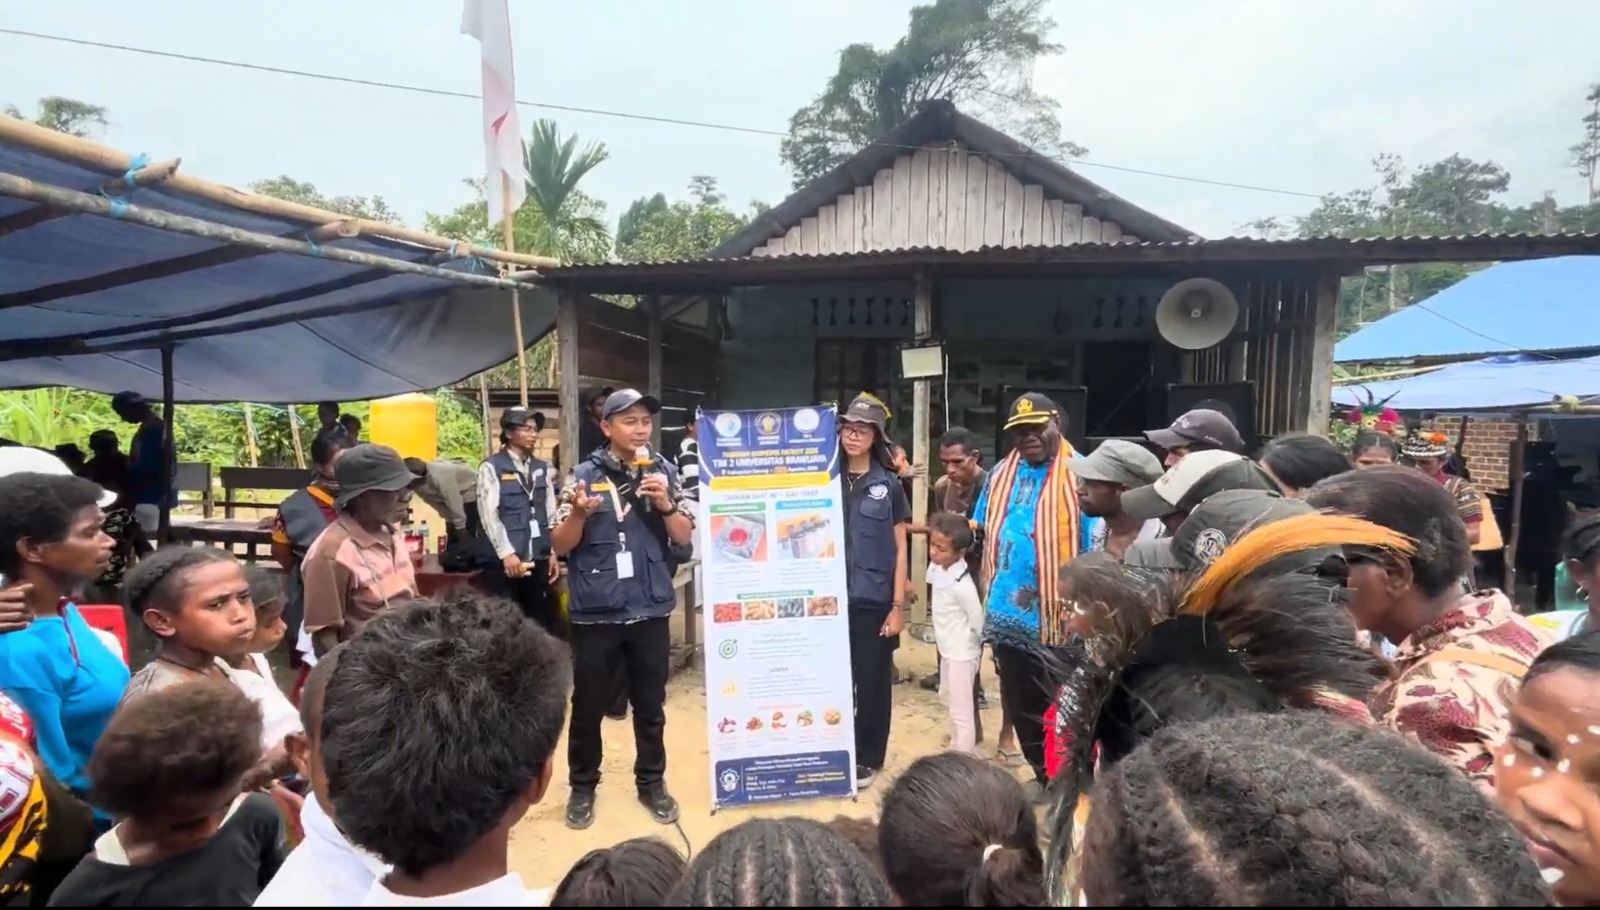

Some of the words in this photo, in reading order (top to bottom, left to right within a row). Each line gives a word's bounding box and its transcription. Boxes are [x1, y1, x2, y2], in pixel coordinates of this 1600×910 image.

[712, 459, 728, 469] TIM
[729, 458, 736, 467] 2
[735, 456, 784, 467] UNIVERSITAS
[785, 454, 828, 465] BRAWIJAYA
